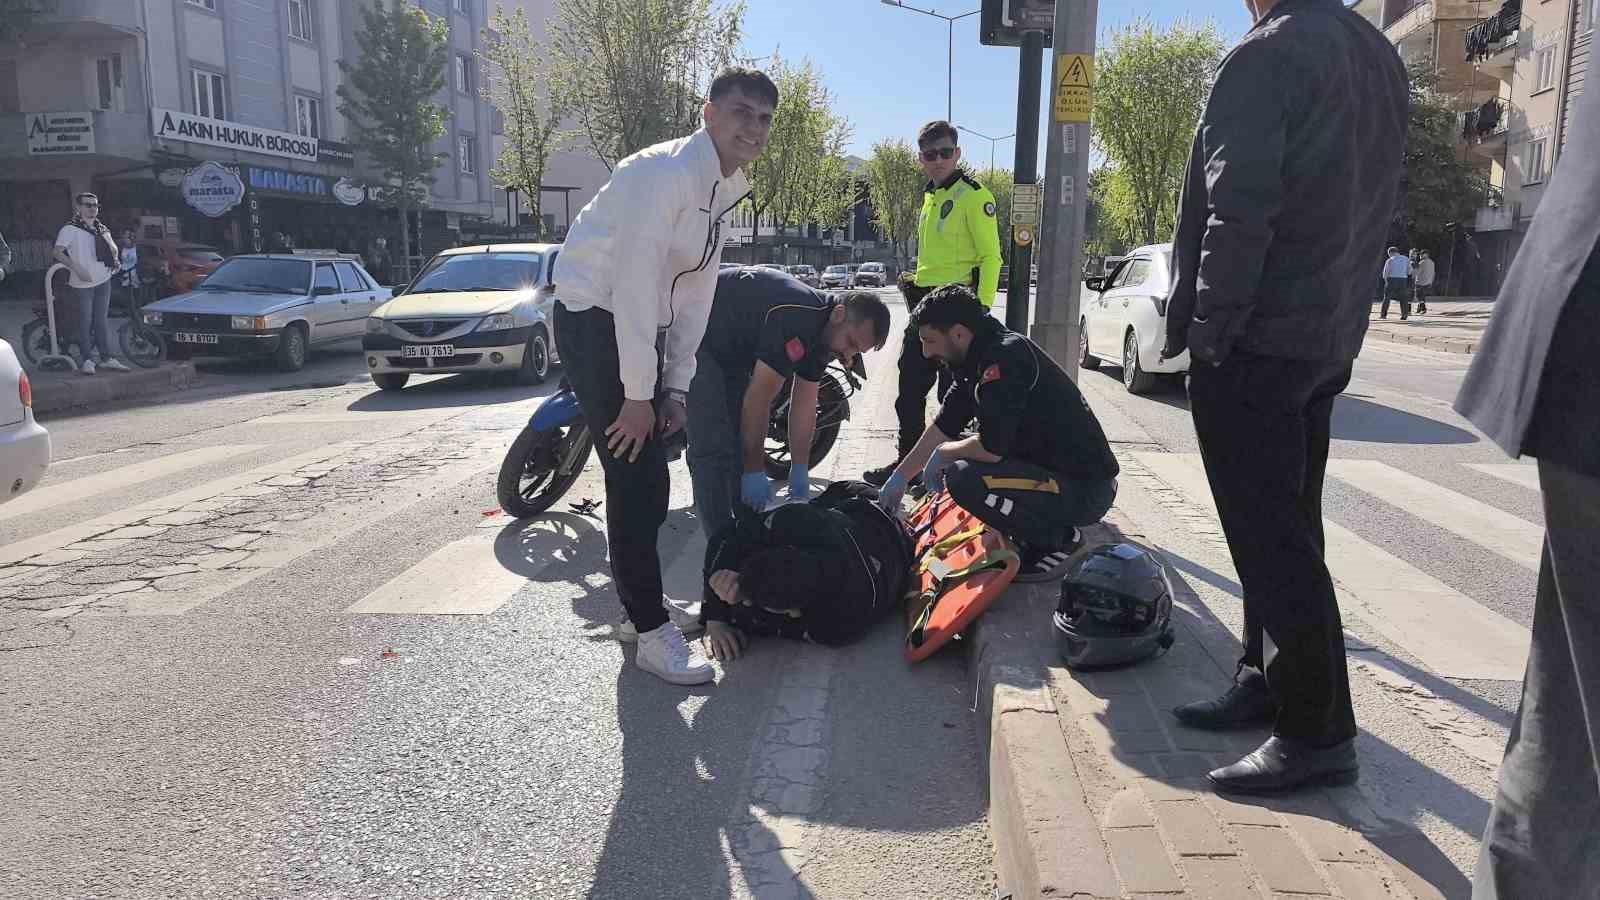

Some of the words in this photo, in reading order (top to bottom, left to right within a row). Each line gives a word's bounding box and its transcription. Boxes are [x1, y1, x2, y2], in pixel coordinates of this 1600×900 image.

[178, 119, 214, 141] AKIN
[216, 127, 265, 149] HUKUK
[266, 135, 316, 157] BÜROSU
[189, 186, 235, 197] marasta
[407, 345, 416, 356] 35
[420, 345, 430, 356] AU
[432, 345, 453, 356] 7613
